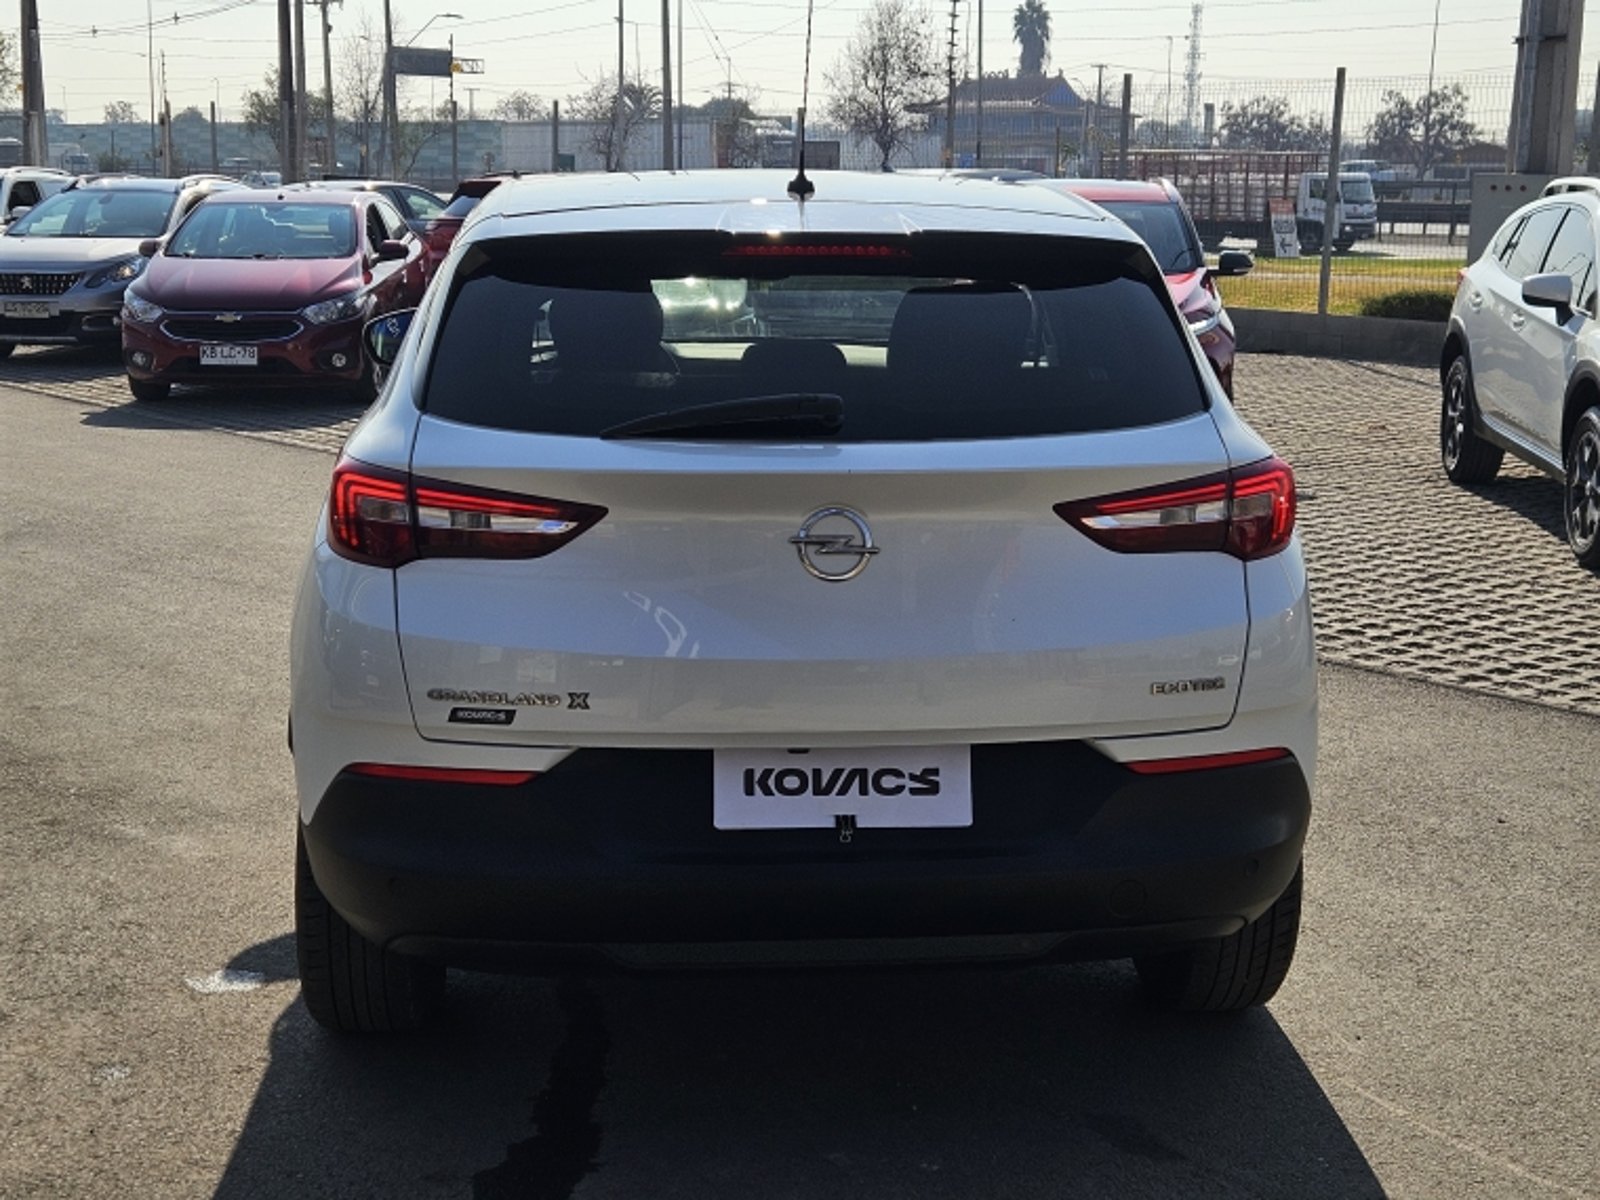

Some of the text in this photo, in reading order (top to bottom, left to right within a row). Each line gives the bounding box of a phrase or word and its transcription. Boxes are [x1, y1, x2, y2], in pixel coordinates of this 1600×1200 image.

[426, 687, 591, 710] GRANDLAND X
[743, 767, 941, 797] KOVACS
